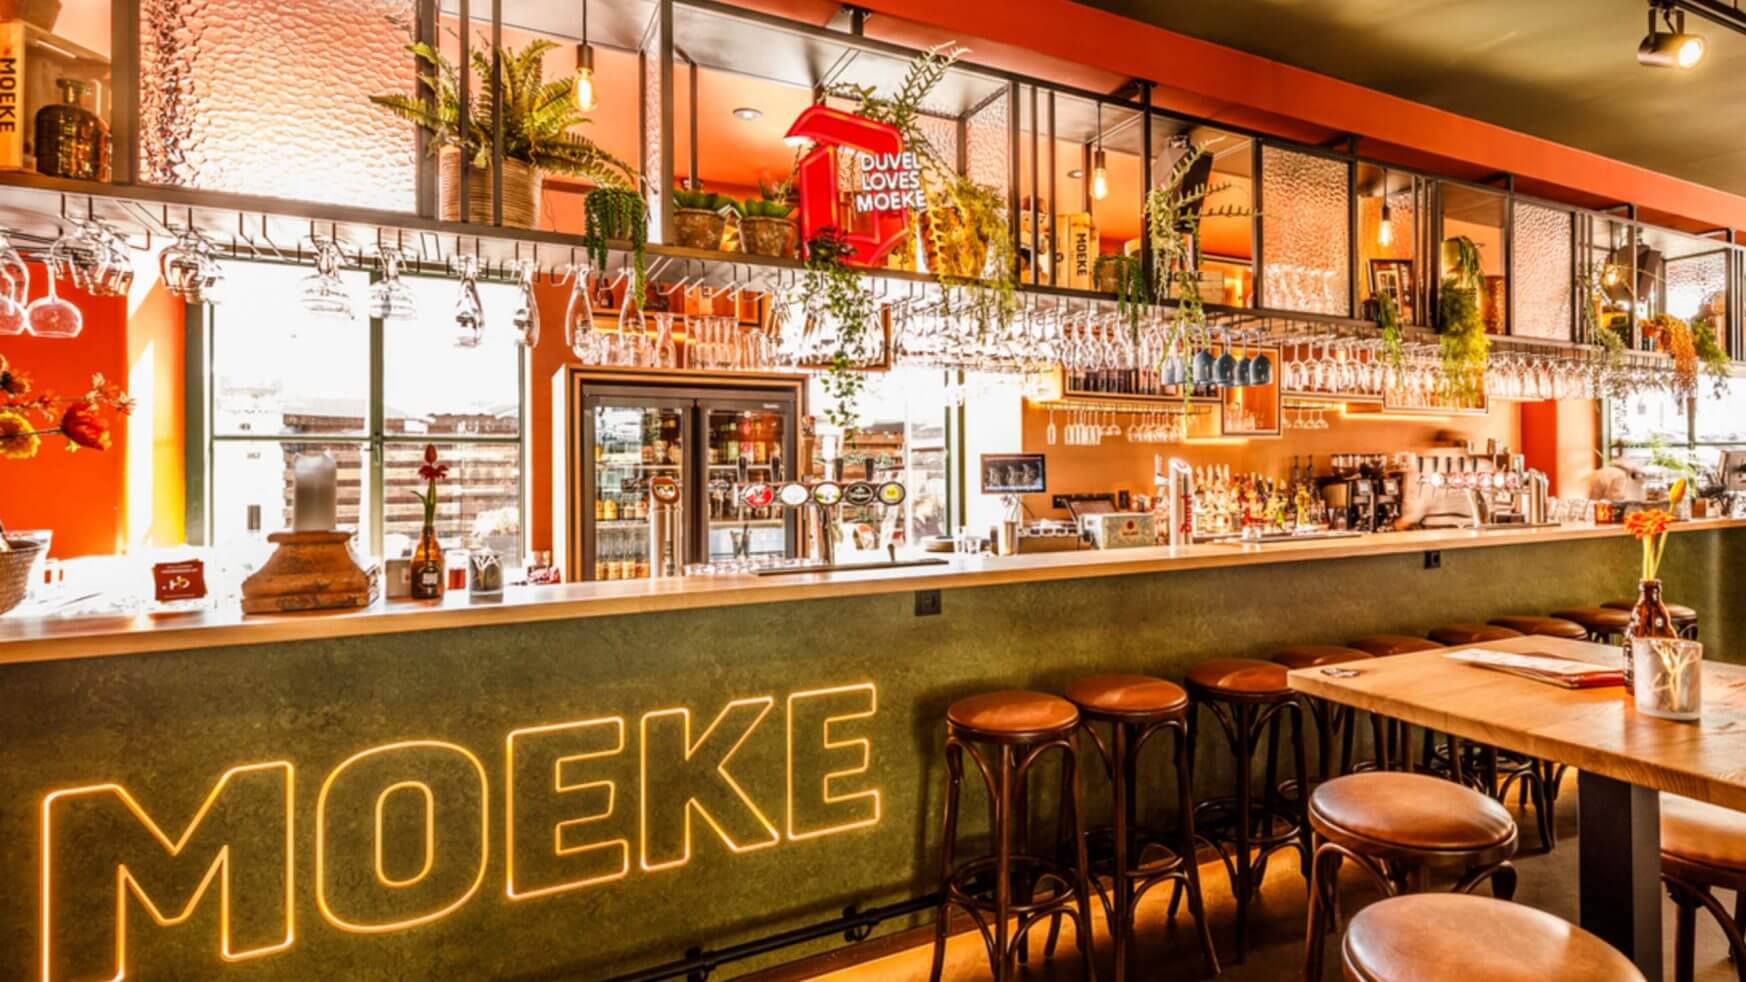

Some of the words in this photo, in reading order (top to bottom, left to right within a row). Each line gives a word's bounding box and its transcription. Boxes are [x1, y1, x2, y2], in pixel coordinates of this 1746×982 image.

[0, 58, 16, 133] MOEKE
[861, 151, 921, 171] DUVEL
[862, 171, 920, 191] LOVES
[855, 191, 926, 212] MOEKE
[1075, 232, 1088, 277] MOEKE
[41, 683, 882, 982] MOEKE
